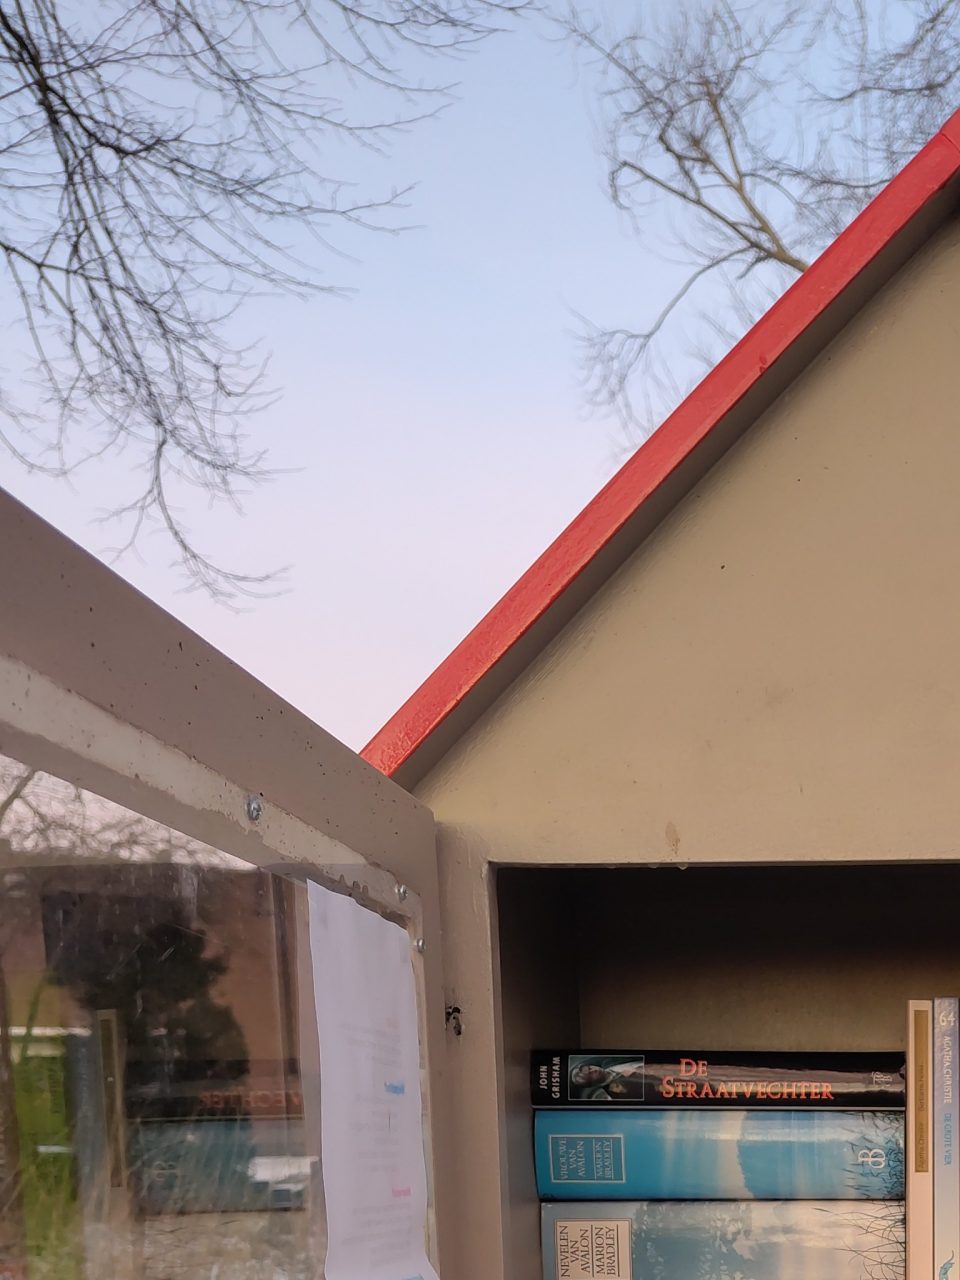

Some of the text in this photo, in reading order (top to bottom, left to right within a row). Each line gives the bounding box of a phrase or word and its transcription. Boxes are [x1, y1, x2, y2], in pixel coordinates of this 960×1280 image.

[539, 1065, 548, 1090] JOHN
[551, 1056, 560, 1098] GRISHAM
[661, 1076, 834, 1099] STRAATVECHTER
[679, 1059, 708, 1077] DE
[943, 1035, 952, 1104] AGATHA CHRISTIE
[560, 1138, 568, 1180] VROUWE
[569, 1149, 577, 1169] VAN
[577, 1140, 586, 1177] AVALON
[595, 1141, 603, 1177] MARION
[603, 1139, 612, 1178] BRADLEY
[560, 1225, 570, 1279] NEVELEN
[570, 1240, 579, 1263] VAN
[580, 1228, 590, 1274] AVALON
[595, 1226, 605, 1276] MARION
[605, 1225, 616, 1277] BRADLEY
